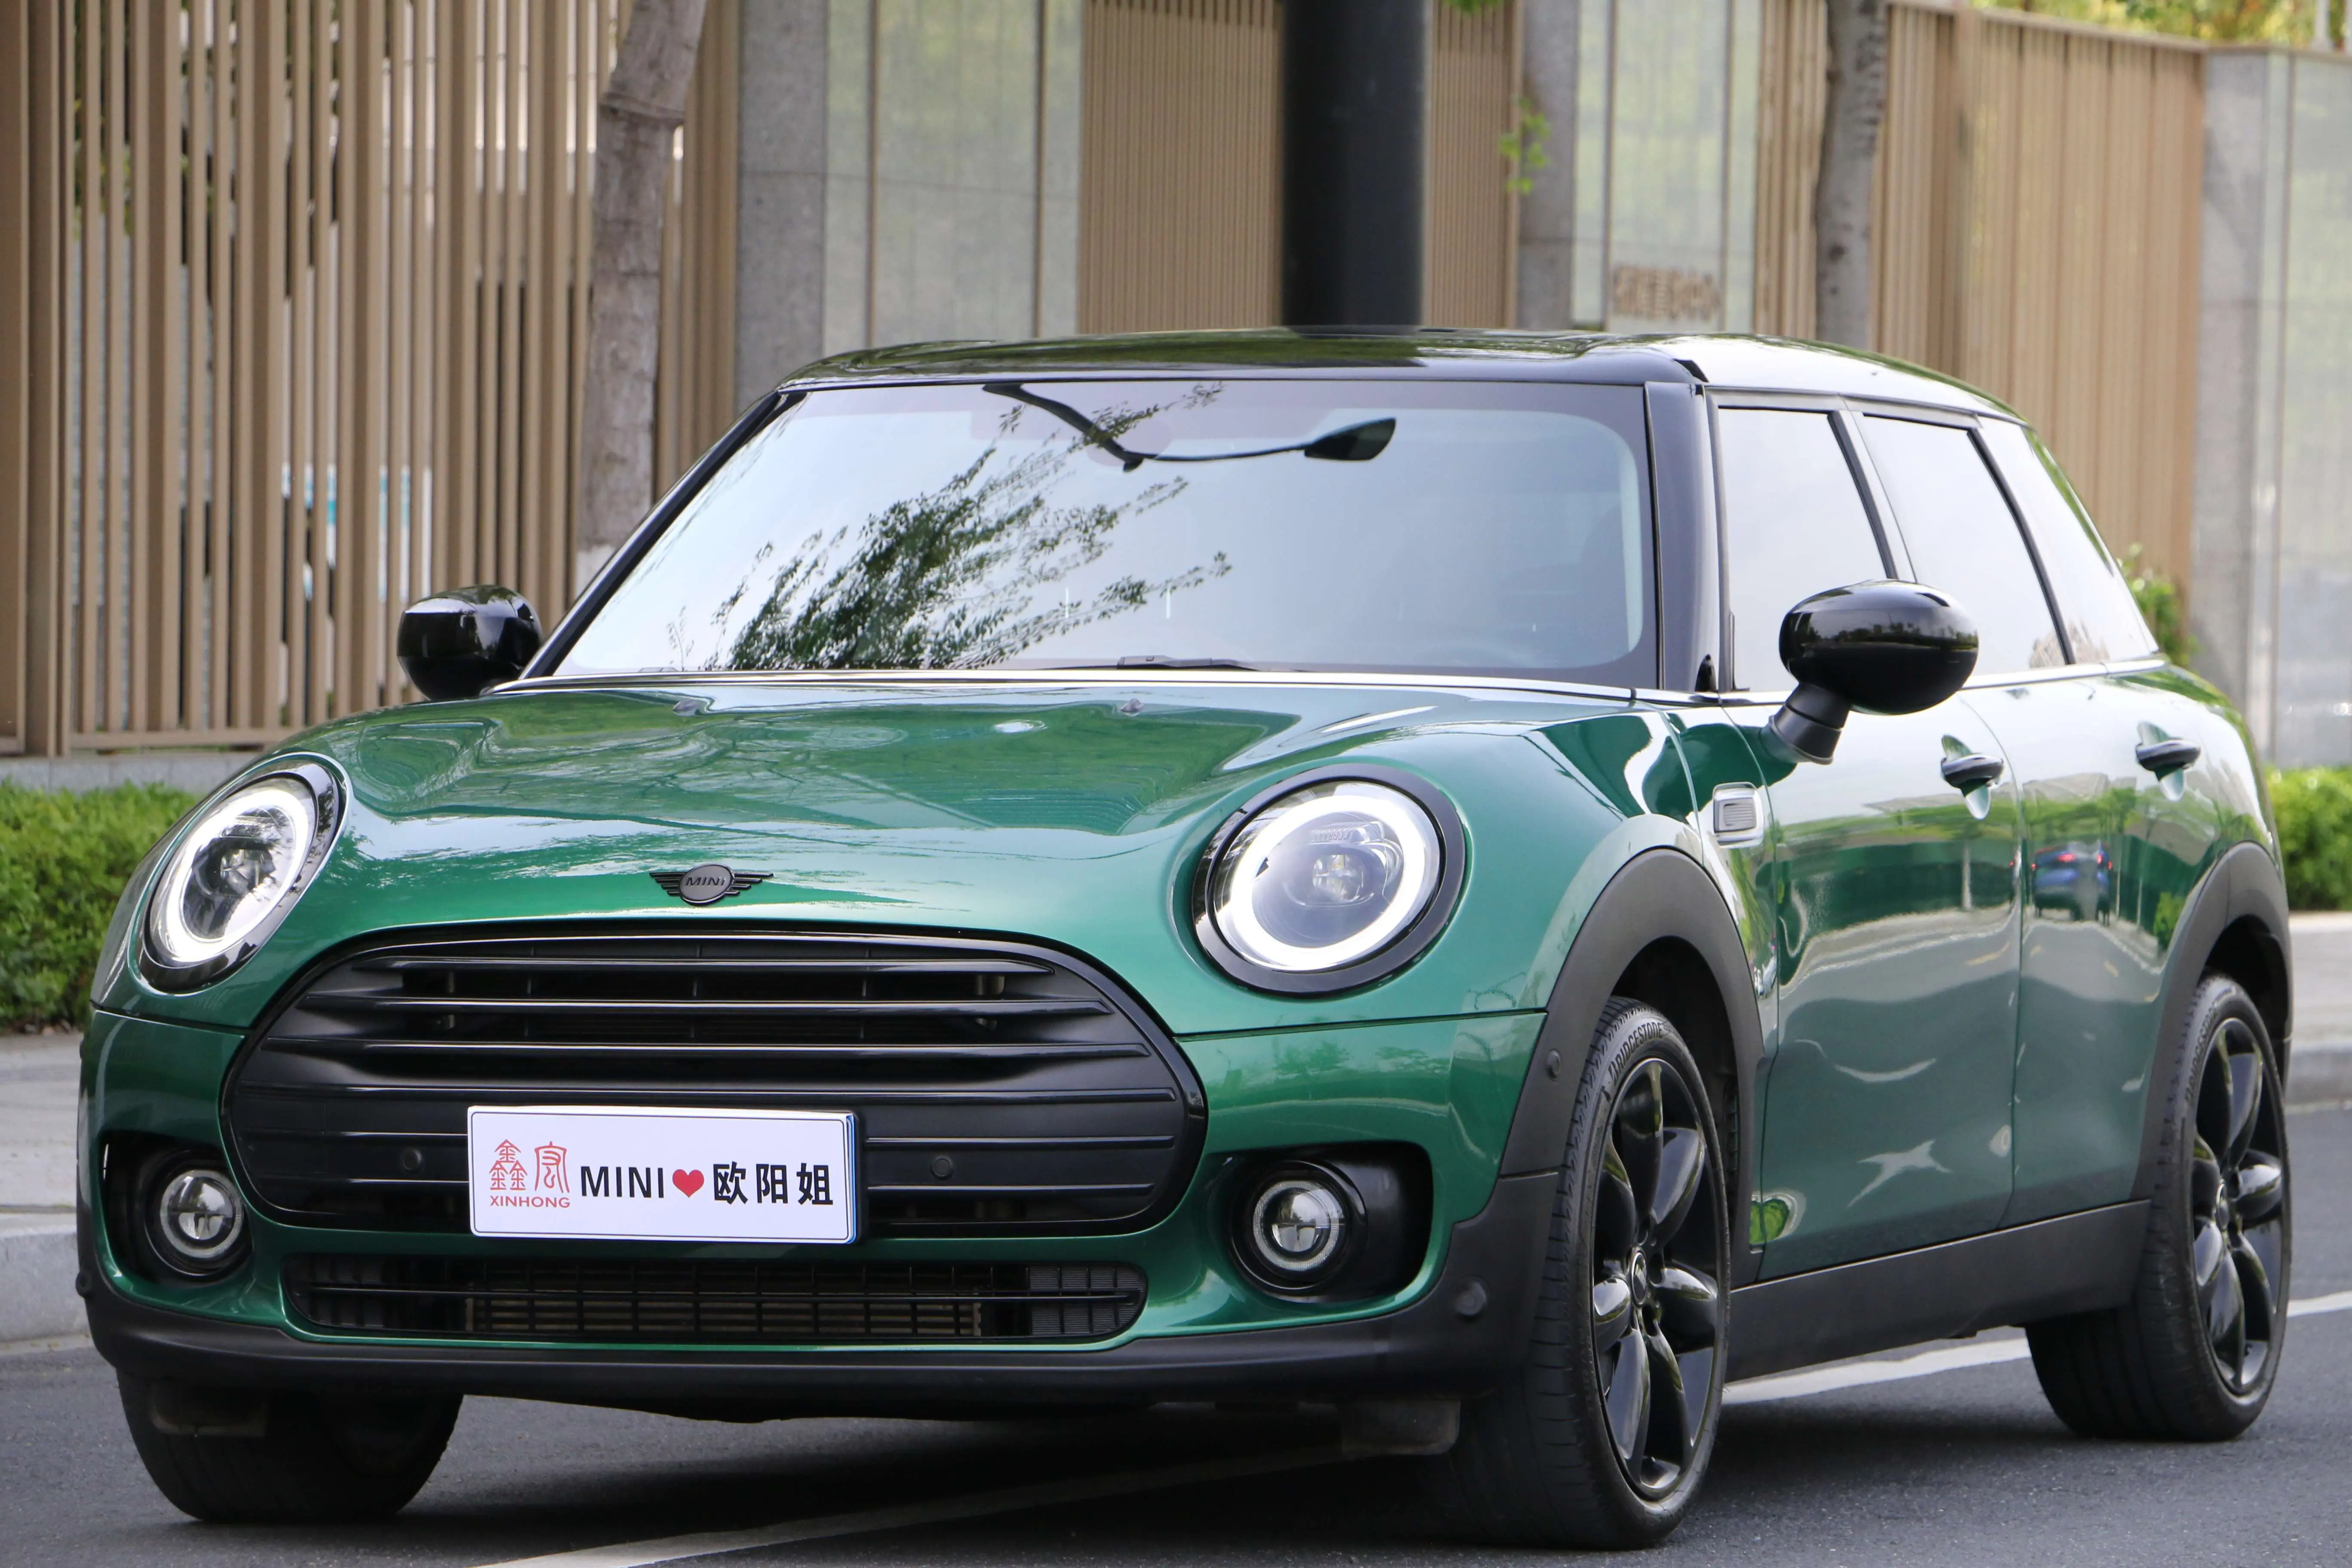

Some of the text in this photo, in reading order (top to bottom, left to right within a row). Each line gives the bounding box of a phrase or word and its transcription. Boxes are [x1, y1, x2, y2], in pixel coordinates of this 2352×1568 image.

[685, 876, 726, 886] MINI
[1608, 1021, 1665, 1086] BRIDGESTONE
[580, 1161, 833, 1205] MINI 欧阳姐
[490, 1195, 570, 1208] XINHONG
